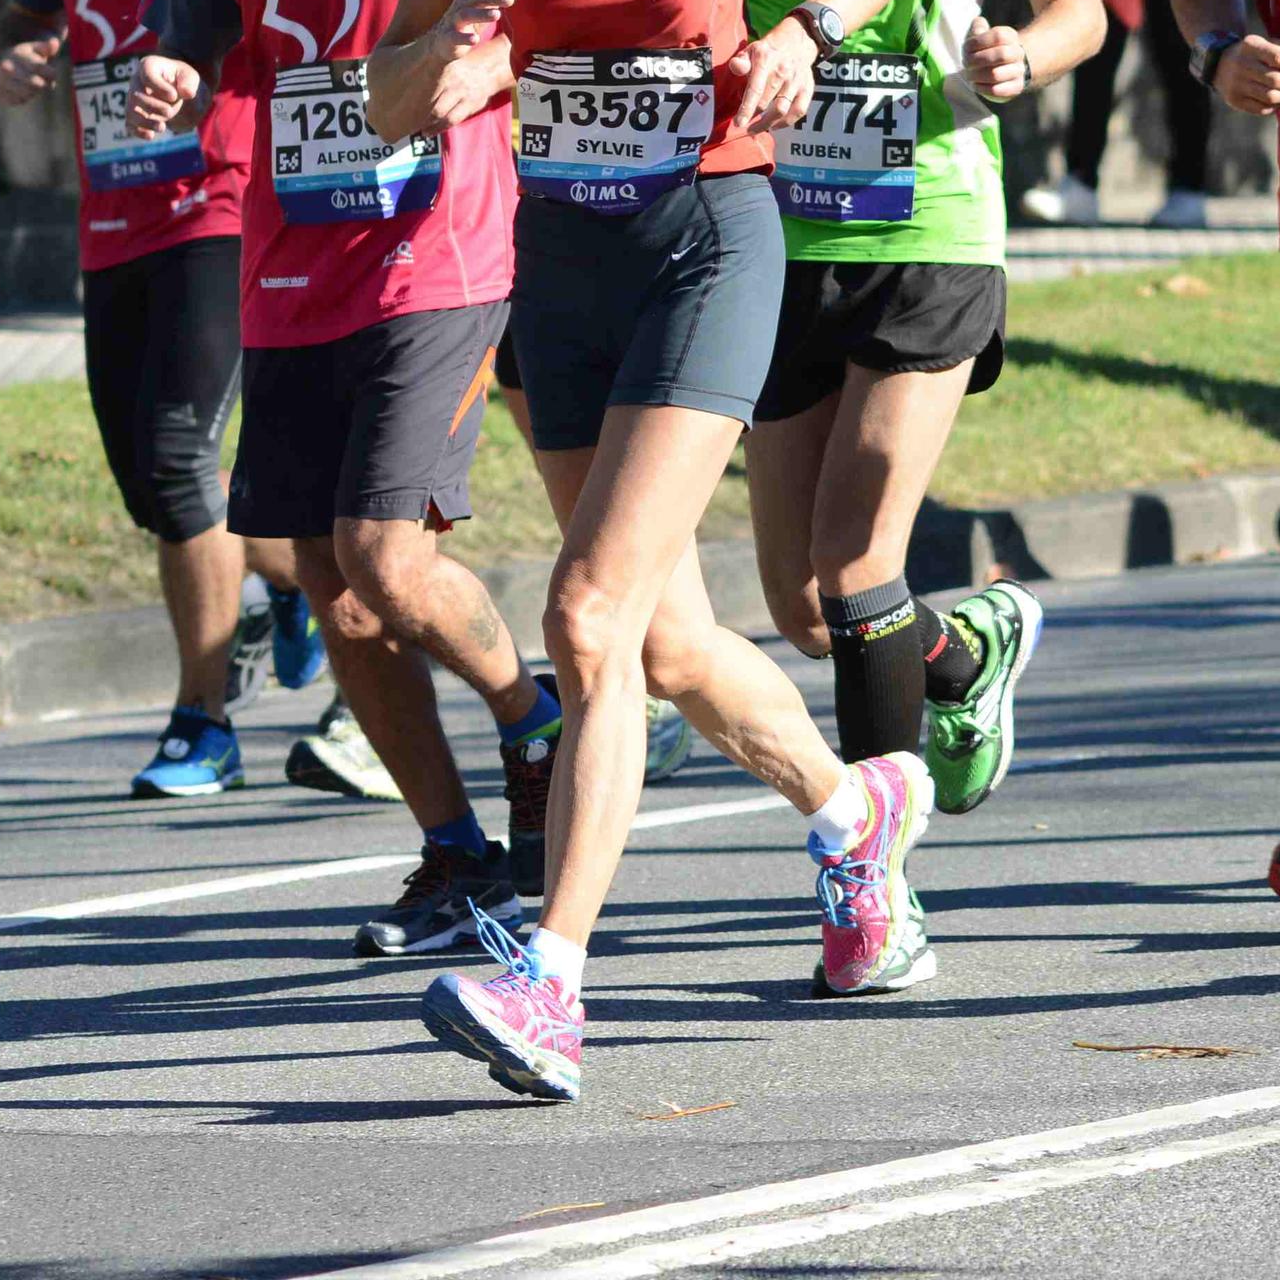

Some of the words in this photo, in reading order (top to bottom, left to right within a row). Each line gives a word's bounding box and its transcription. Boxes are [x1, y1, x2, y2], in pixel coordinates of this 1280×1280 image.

[611, 56, 704, 79] adidas
[821, 58, 911, 83] adidas
[90, 91, 126, 123] 143
[540, 89, 694, 134] 13587
[291, 100, 378, 141] 126
[317, 145, 394, 165] ALFONSO
[576, 139, 643, 158] SYLVIE
[790, 142, 851, 160] RUBÉN
[350, 188, 394, 206] IMQ
[590, 184, 639, 202] IMQ
[805, 189, 853, 208] IMQ
